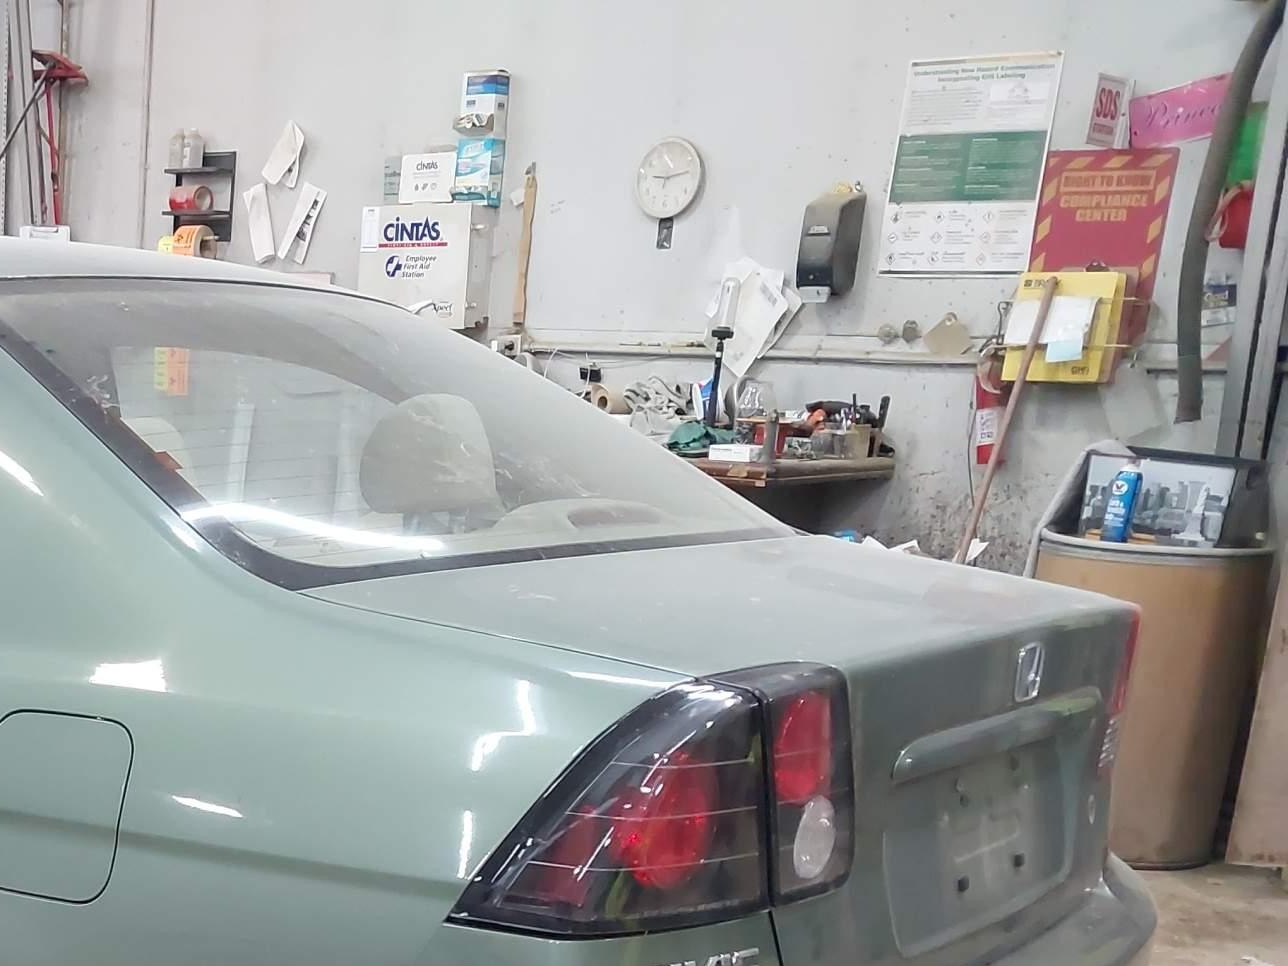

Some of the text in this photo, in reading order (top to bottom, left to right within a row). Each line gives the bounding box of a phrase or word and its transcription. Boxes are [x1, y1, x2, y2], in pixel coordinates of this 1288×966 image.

[1096, 88, 1120, 120] SDS
[1060, 194, 1149, 208] COMPLIANCE
[1075, 208, 1128, 222] CENTER
[405, 255, 437, 263] Employee
